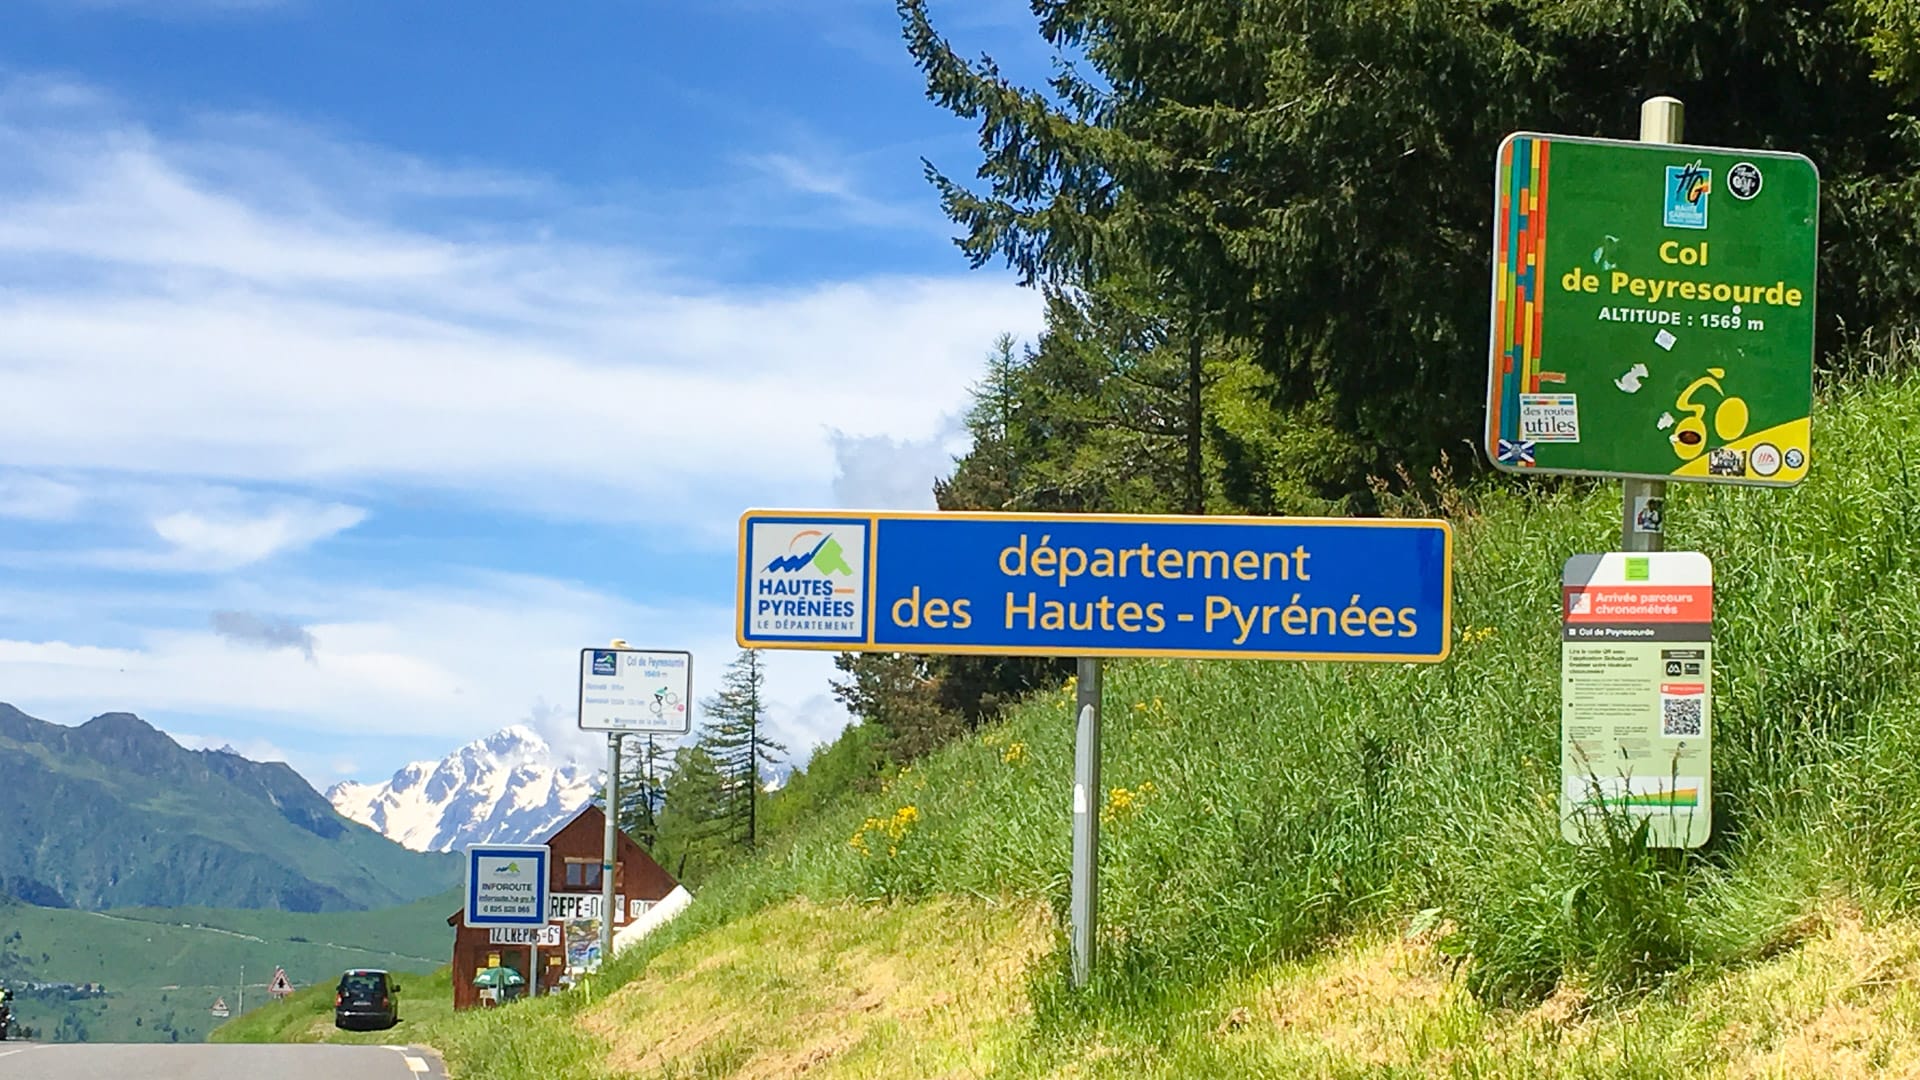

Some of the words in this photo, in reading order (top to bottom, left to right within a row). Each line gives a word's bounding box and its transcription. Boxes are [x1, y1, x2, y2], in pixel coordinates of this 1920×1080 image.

[1659, 241, 1708, 266] Col
[1562, 267, 1600, 292] de
[1611, 271, 1802, 306] Peyresourde
[1598, 306, 1681, 325] ALTITUDE
[1700, 313, 1741, 329] 1569
[1748, 317, 1764, 330] m
[1523, 406, 1540, 416] des
[1544, 407, 1575, 416] routes
[1525, 416, 1576, 433] utiles
[999, 534, 1311, 587] département
[758, 596, 855, 617] PYRÉNÉES
[1596, 592, 1638, 603] Arrivée
[1641, 593, 1693, 605] parcours
[891, 586, 972, 629] des
[1596, 604, 1678, 614] chronométrés
[758, 620, 769, 629] LE
[776, 619, 855, 630] DÉPARTEMENT
[1579, 628, 1592, 636] Col
[1594, 628, 1604, 636] de
[1605, 628, 1655, 638] Peyresourde
[482, 883, 532, 891] INFOROUTE
